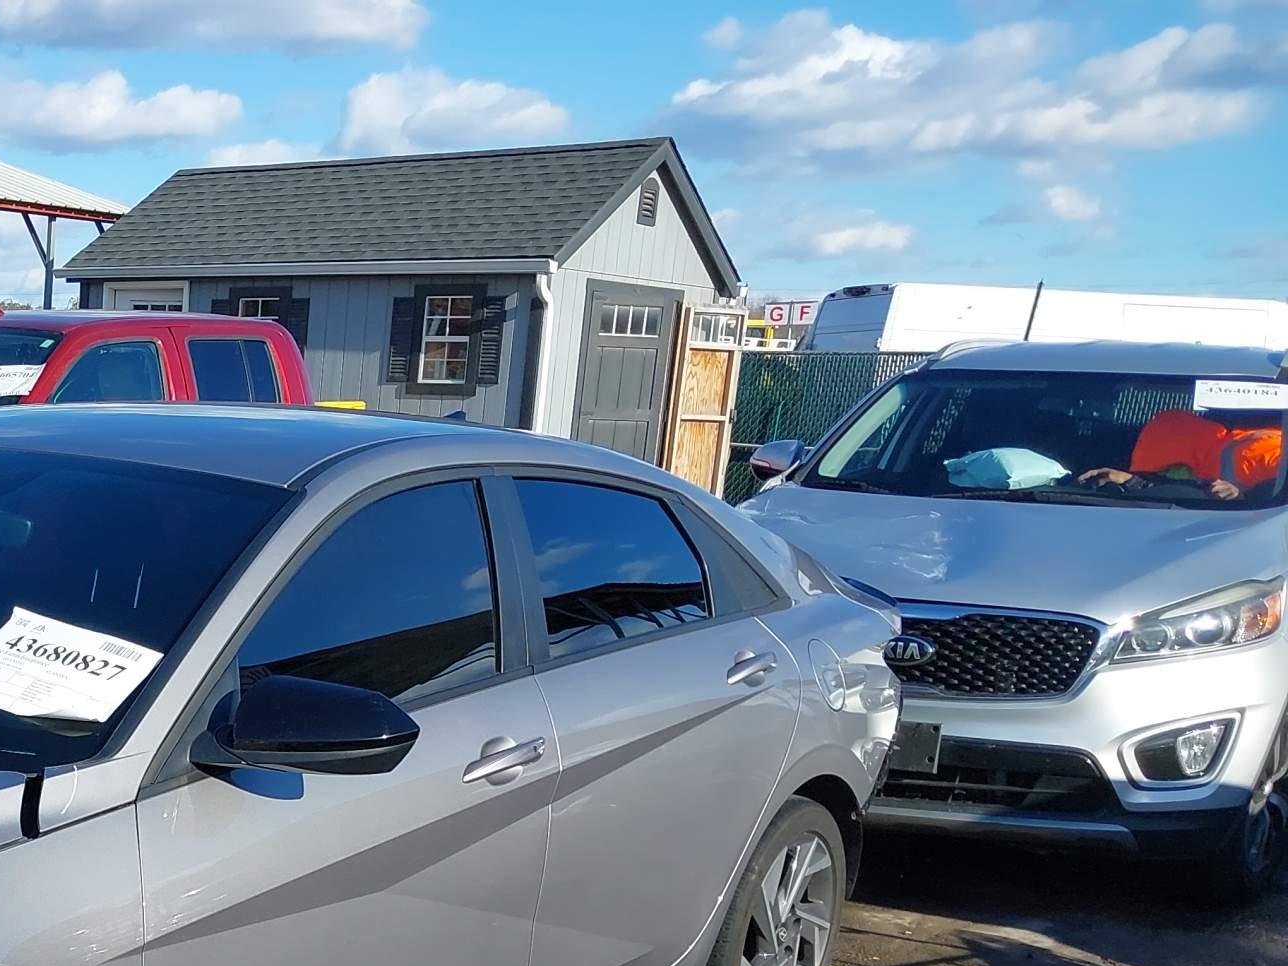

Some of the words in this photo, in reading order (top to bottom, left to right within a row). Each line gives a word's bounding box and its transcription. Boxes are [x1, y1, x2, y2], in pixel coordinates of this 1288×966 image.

[770, 306, 784, 322] G
[799, 305, 812, 321] F
[5, 635, 128, 681] 43680827
[884, 641, 921, 660] KIA
